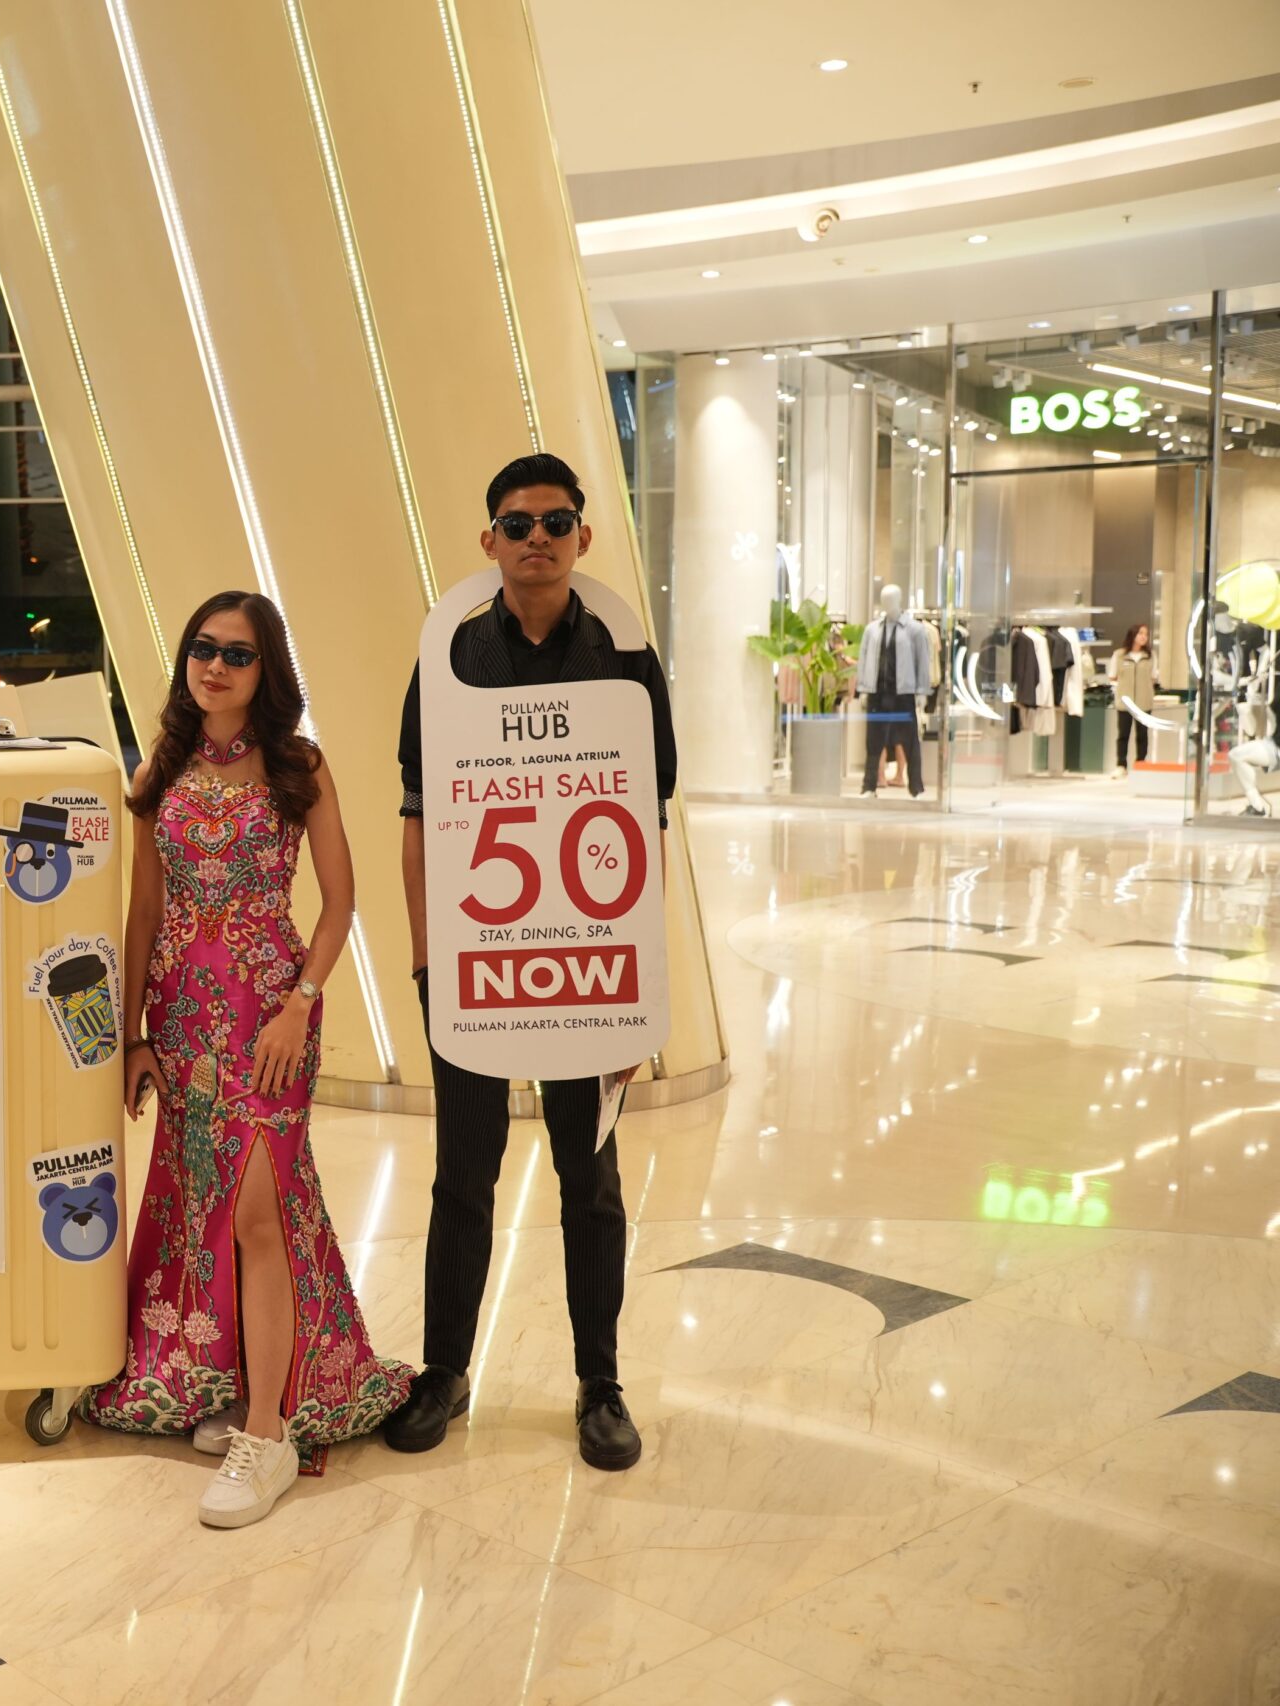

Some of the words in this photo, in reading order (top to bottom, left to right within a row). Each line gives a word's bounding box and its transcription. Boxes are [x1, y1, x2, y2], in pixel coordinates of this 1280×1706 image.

[1010, 386, 1142, 434] BOSS
[501, 700, 569, 715] PULLMAN
[502, 714, 570, 742] HUB
[456, 759, 471, 769] GF
[474, 757, 516, 768] FLOOR,
[522, 753, 572, 765] LAGUNA
[575, 751, 621, 762] ATRIUM
[451, 775, 544, 804] FLASH
[556, 770, 628, 798] SALE
[52, 797, 98, 805] PULLMAN
[72, 817, 109, 827] FLASH
[438, 821, 452, 831] UP
[454, 820, 469, 830] TO
[72, 827, 109, 841] SALE
[479, 929, 515, 943] STAY,
[521, 926, 580, 941] DINING,
[586, 925, 613, 938] SPA
[29, 965, 45, 993] Fuel
[42, 947, 65, 969] your
[68, 938, 92, 952] day.
[472, 954, 626, 1000] NOW
[453, 1021, 507, 1032] PULLMAN
[509, 1019, 560, 1032] JAKARTA
[563, 1017, 615, 1029] CENTRAL
[618, 1016, 647, 1028] PARK
[32, 1144, 113, 1175] PULLMAN
[36, 1171, 67, 1182] JAKARTA
[67, 1164, 98, 1174] CENTRAL
[99, 1157, 114, 1168] PARK
